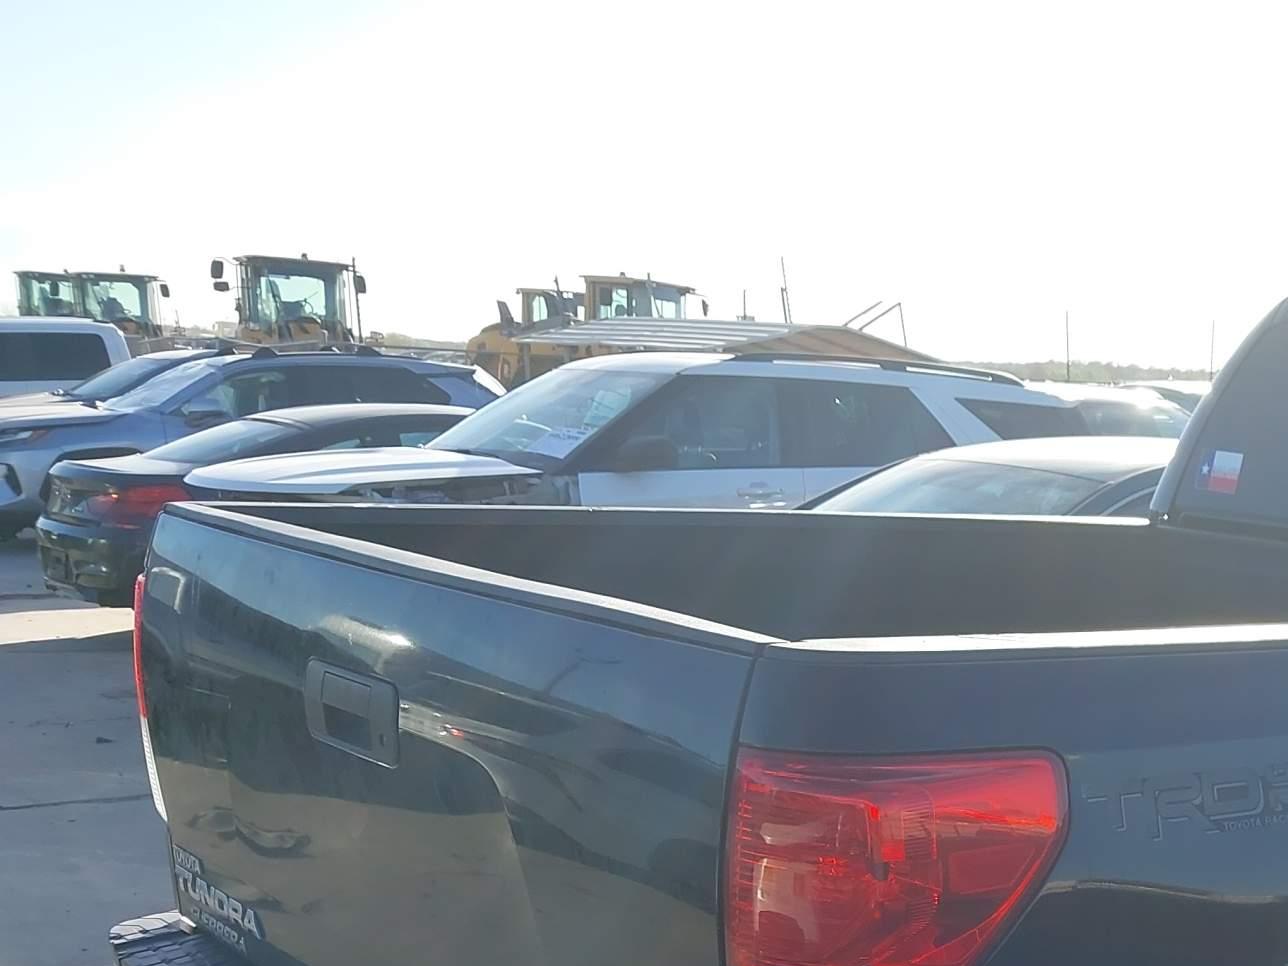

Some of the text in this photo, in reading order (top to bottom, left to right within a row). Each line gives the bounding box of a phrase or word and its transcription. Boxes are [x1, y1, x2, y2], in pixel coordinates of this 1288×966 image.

[1080, 770, 1265, 841] TRD
[1222, 817, 1264, 834] TOYOTA
[174, 864, 262, 941] TUNDRA
